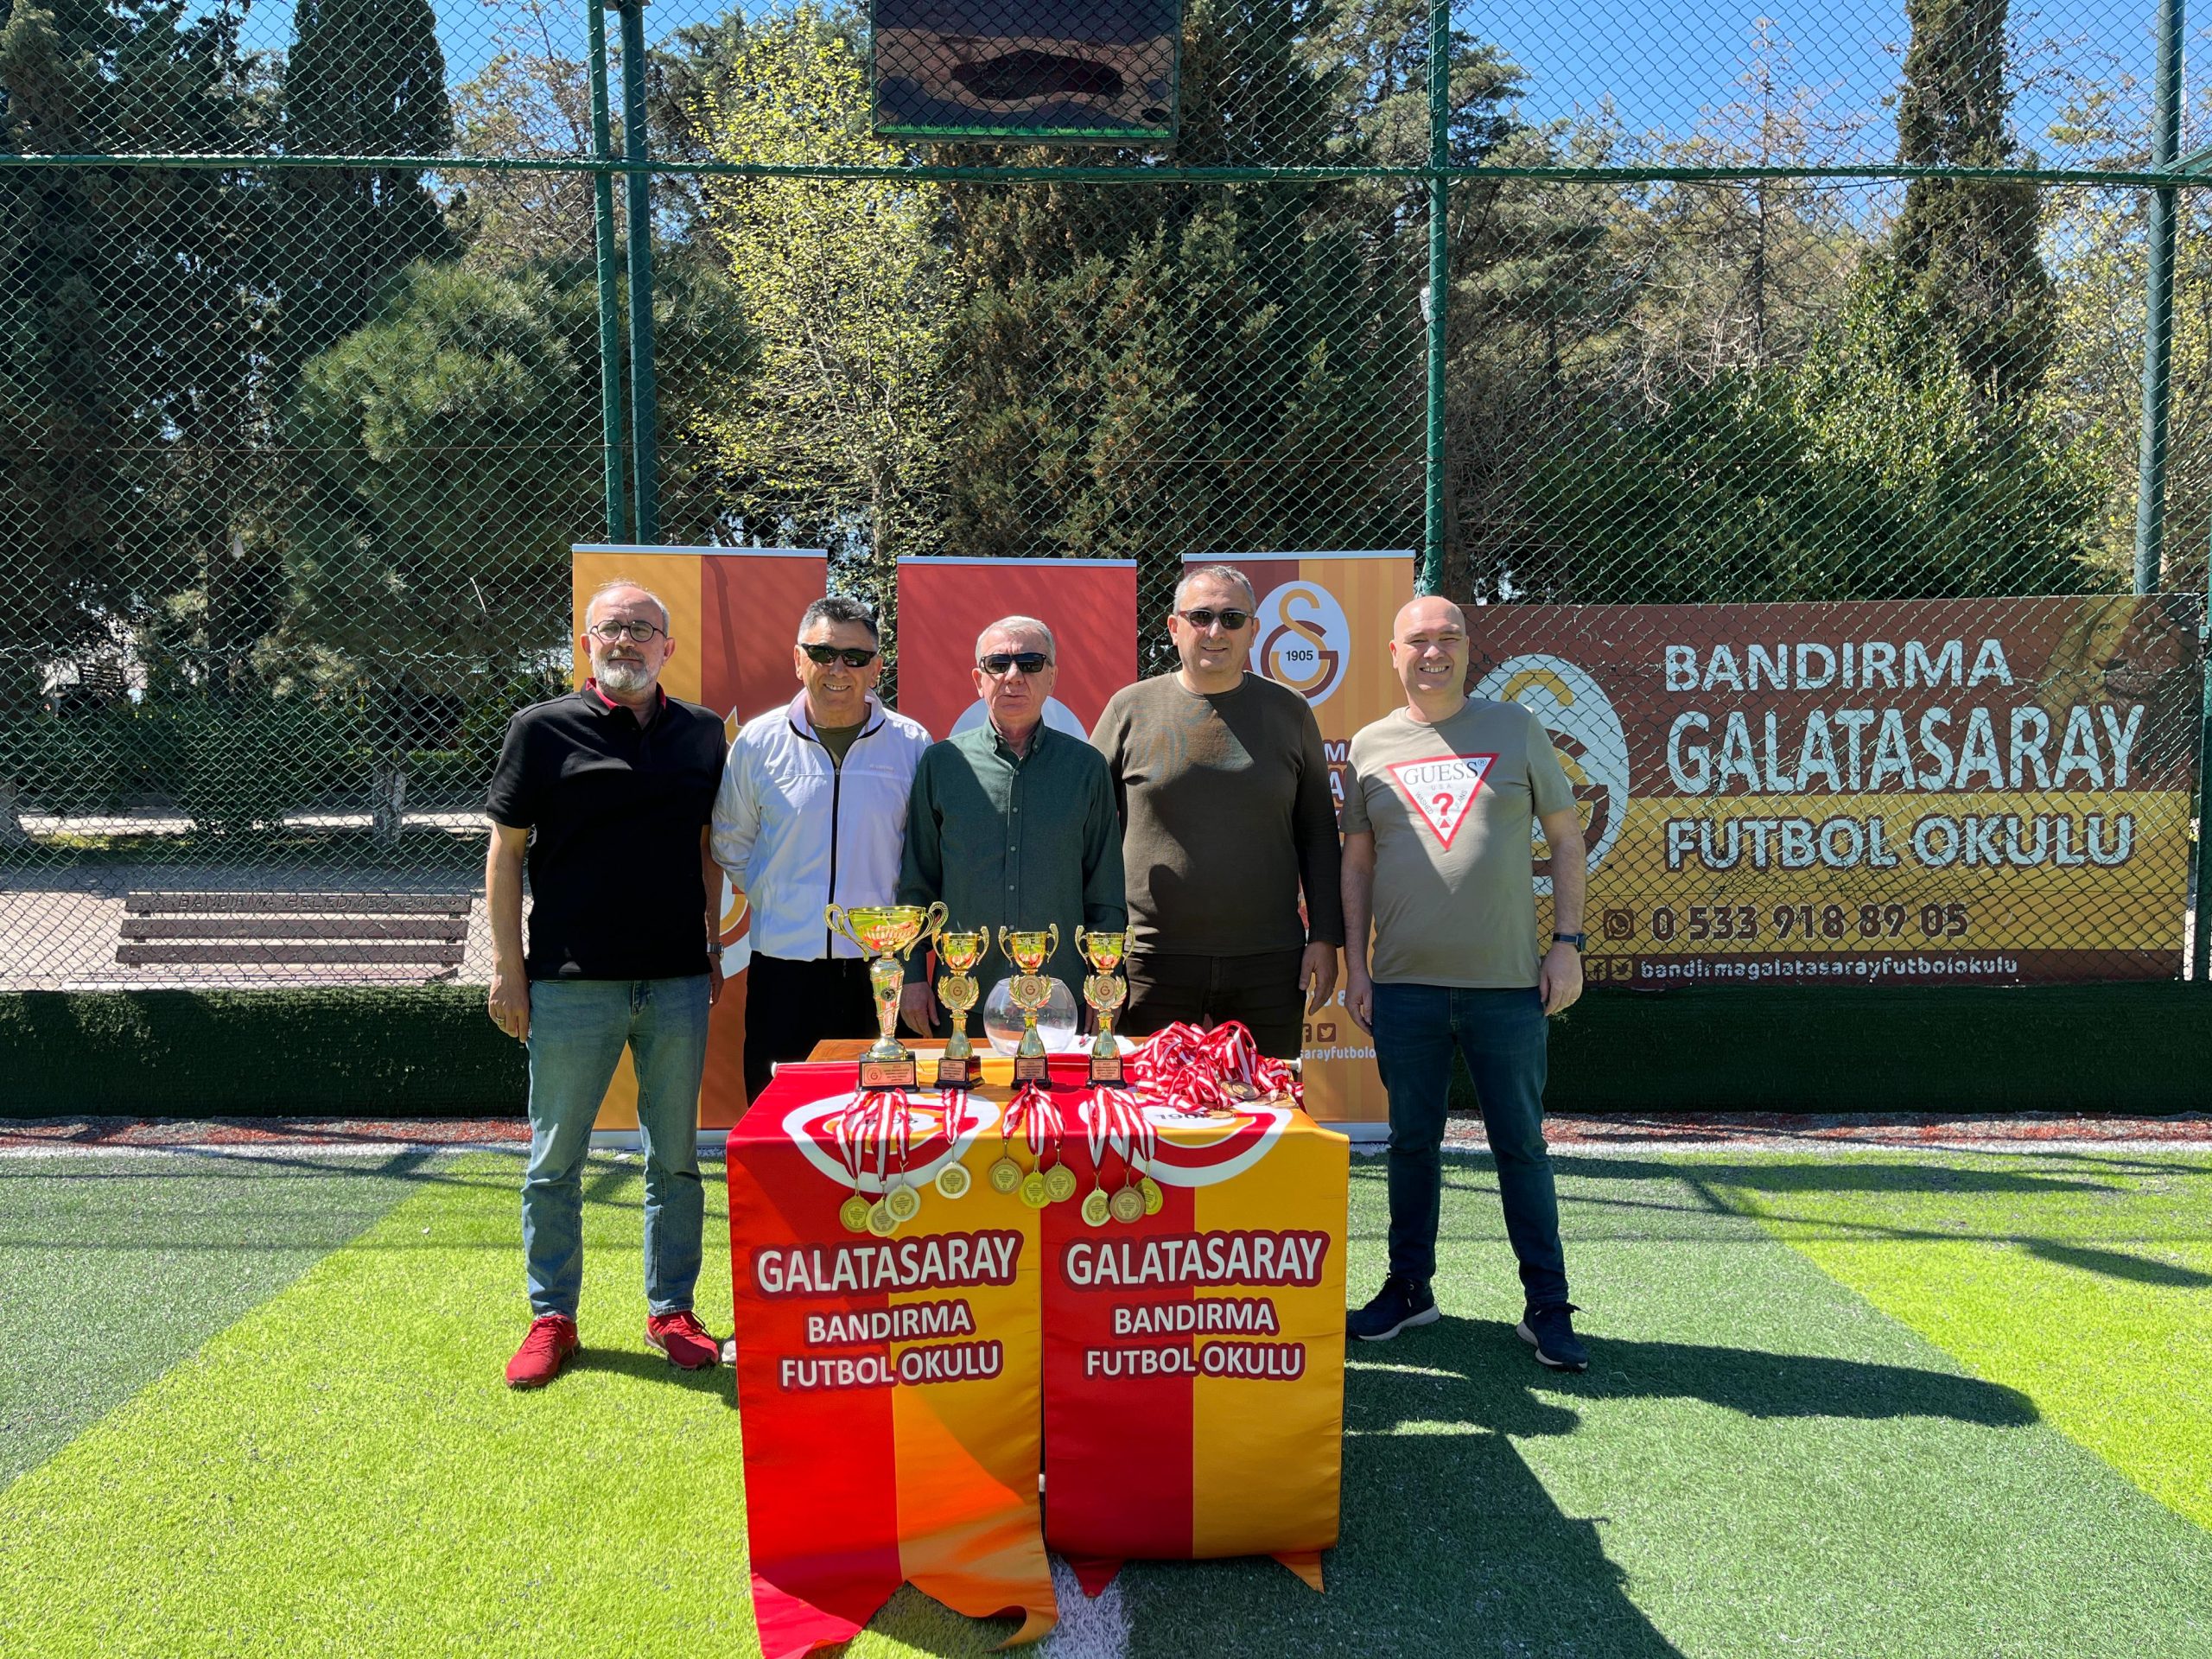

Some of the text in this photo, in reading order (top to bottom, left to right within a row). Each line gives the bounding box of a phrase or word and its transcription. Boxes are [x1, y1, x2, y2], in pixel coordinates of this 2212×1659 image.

[1286, 650, 1313, 661] 1905
[1664, 639, 2014, 692] BANDIRMA
[1666, 704, 2145, 794] GALATASARAY
[1669, 813, 2132, 869] FUTBOL OKULU
[1651, 901, 1969, 943] 0 533 918 89 05
[758, 1236, 1016, 1294] GALATASARAY
[1066, 1236, 1323, 1286] GALATASARAY
[808, 1304, 971, 1343] BANDIRMA
[1115, 1303, 1274, 1334] BANDIRMA
[781, 1345, 999, 1387] FUTBOL OKULU
[1087, 1345, 1301, 1376] FUTBOL OKULU
